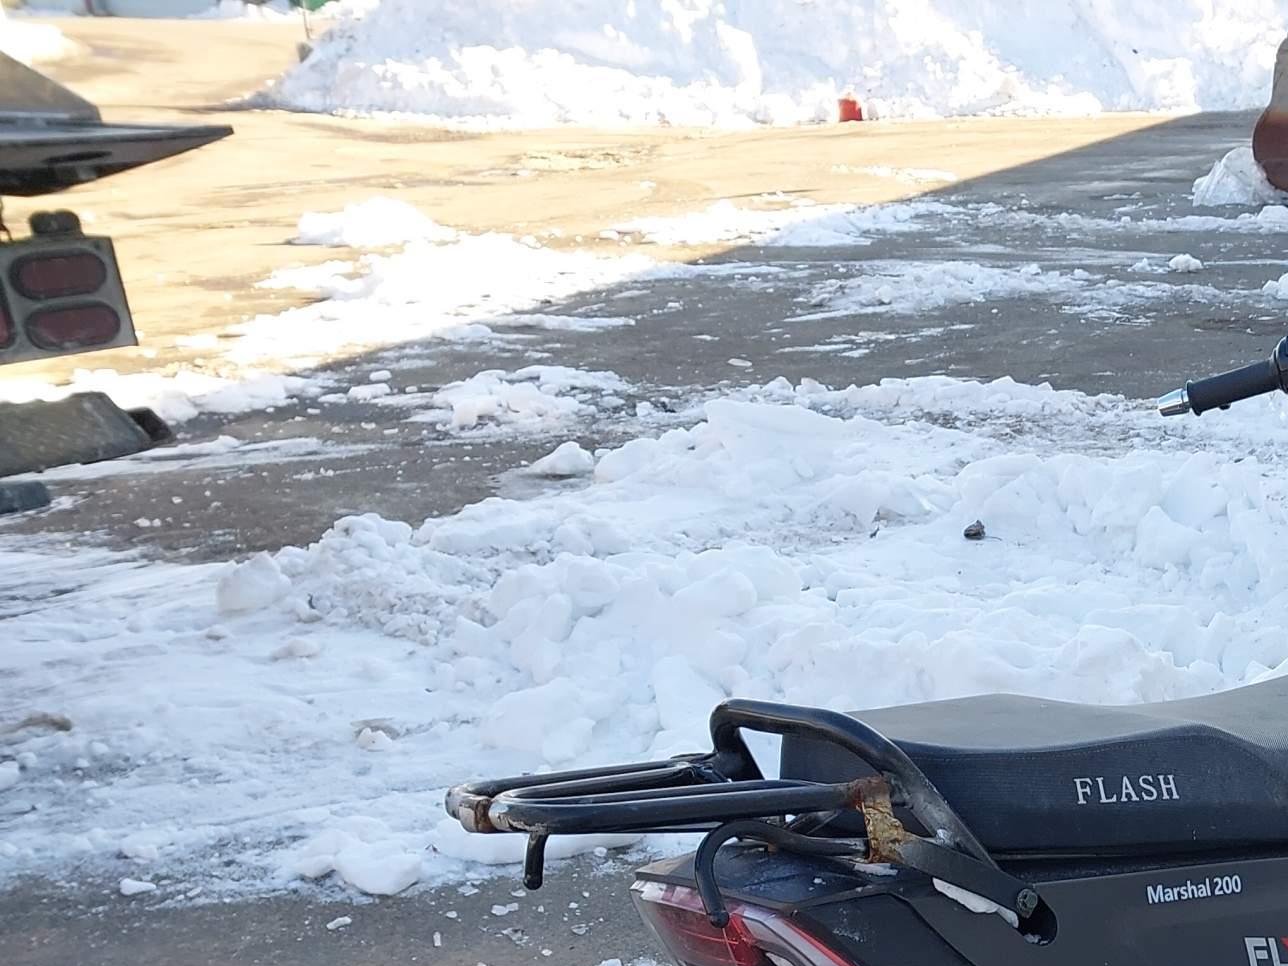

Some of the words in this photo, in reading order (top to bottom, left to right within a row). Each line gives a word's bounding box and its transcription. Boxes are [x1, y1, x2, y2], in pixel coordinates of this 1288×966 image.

[1073, 774, 1180, 804] FLASH
[1146, 878, 1212, 904] Marshal
[1213, 875, 1241, 895] 200
